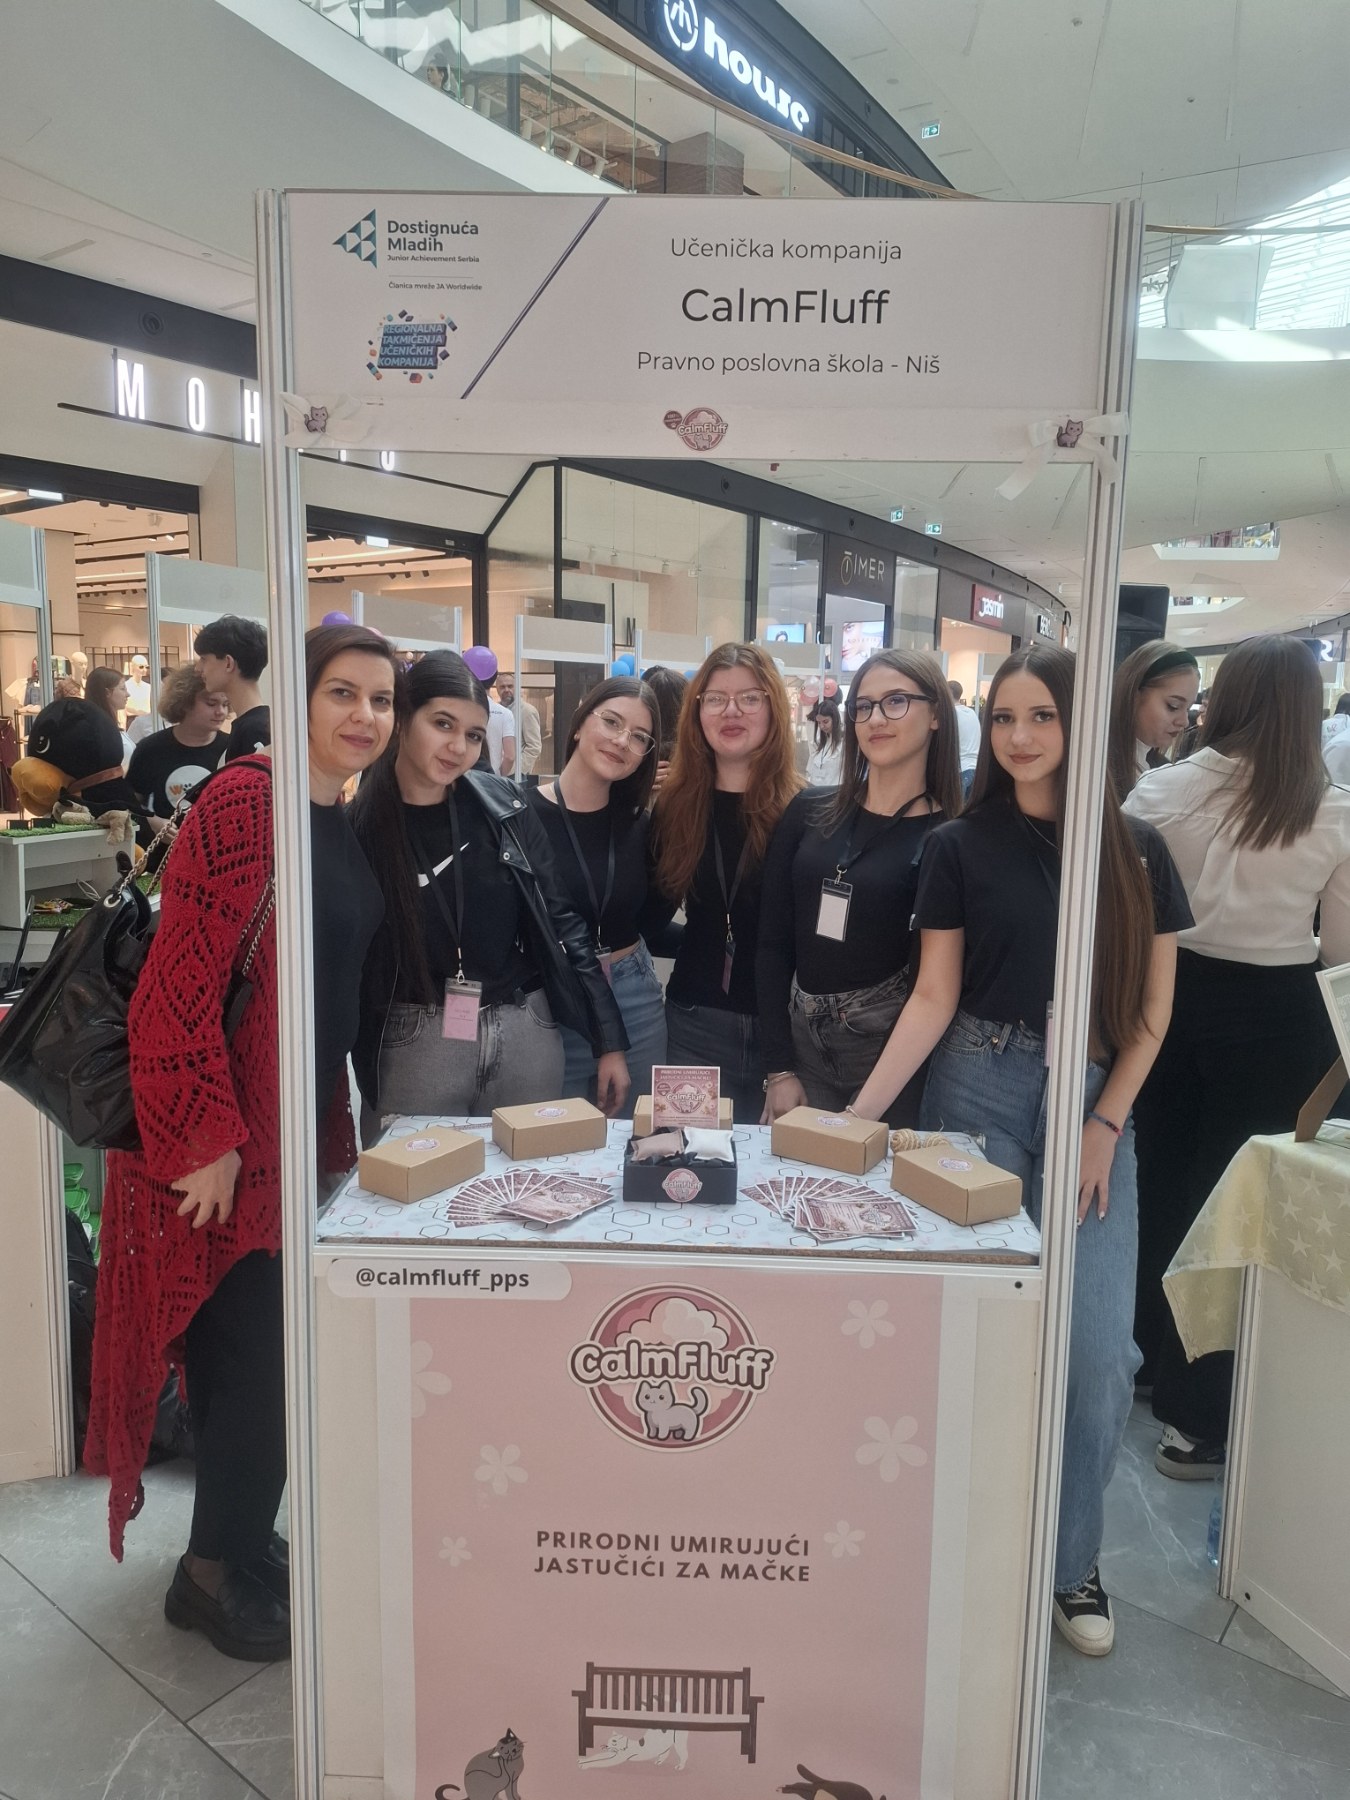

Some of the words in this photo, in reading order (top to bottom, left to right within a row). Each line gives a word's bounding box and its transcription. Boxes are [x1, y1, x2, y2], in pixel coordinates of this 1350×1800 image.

[704, 16, 810, 132] house
[387, 220, 479, 238] Dostignuća
[387, 238, 444, 252] Mladih
[670, 237, 775, 258] Učenička
[782, 239, 902, 264] kompanija
[410, 255, 456, 263] Achievement
[388, 281, 413, 290] Članica
[414, 282, 436, 290] mreže
[436, 283, 446, 291] JA
[446, 283, 483, 291] Worldwide
[681, 287, 891, 324] CalmFluff
[382, 333, 444, 345] TAKMIČENJA
[384, 324, 444, 334] REGIONALNA
[380, 344, 434, 356] UČENIČKIH
[379, 357, 435, 367] KOMPANIJA
[637, 351, 715, 372] Pravno
[722, 352, 820, 375] poslovna
[826, 353, 884, 373] škola
[905, 354, 940, 374] Niš
[355, 1267, 530, 1292] @calmfluff_pps
[570, 1339, 776, 1391] CalmFluff
[536, 1530, 660, 1552] PRIRODNI
[670, 1534, 809, 1557] UMIRUJUĆI
[534, 1554, 665, 1578] JASTUČIĆI
[676, 1562, 710, 1579] ZA
[720, 1559, 810, 1582] MAČKE
